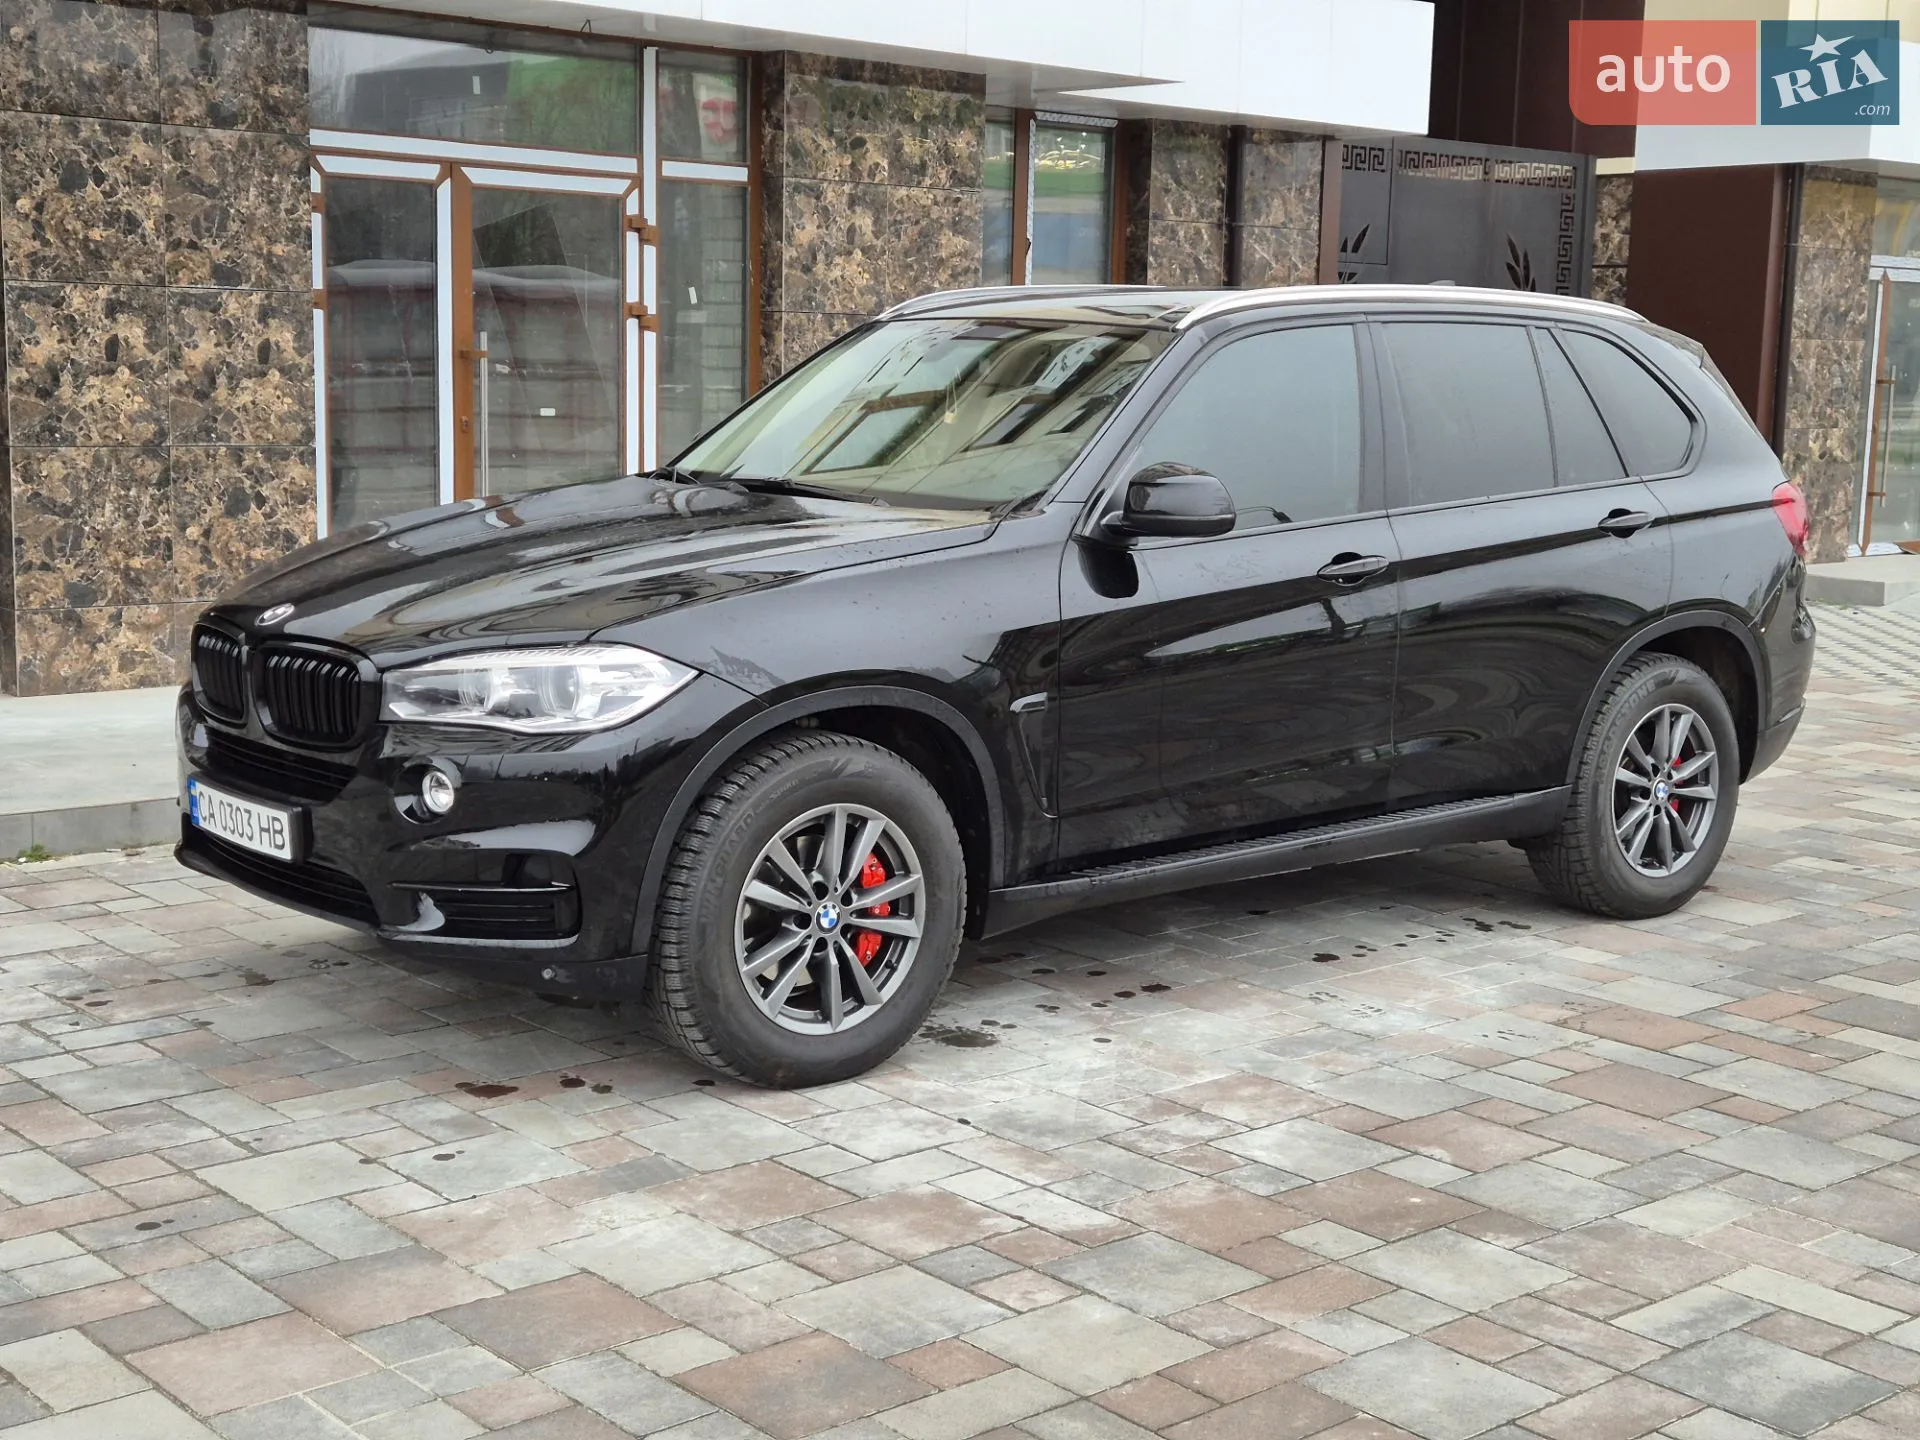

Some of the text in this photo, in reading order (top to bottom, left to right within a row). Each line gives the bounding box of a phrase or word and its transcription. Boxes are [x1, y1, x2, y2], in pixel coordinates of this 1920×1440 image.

[198, 790, 286, 851] CA 0303 HB
